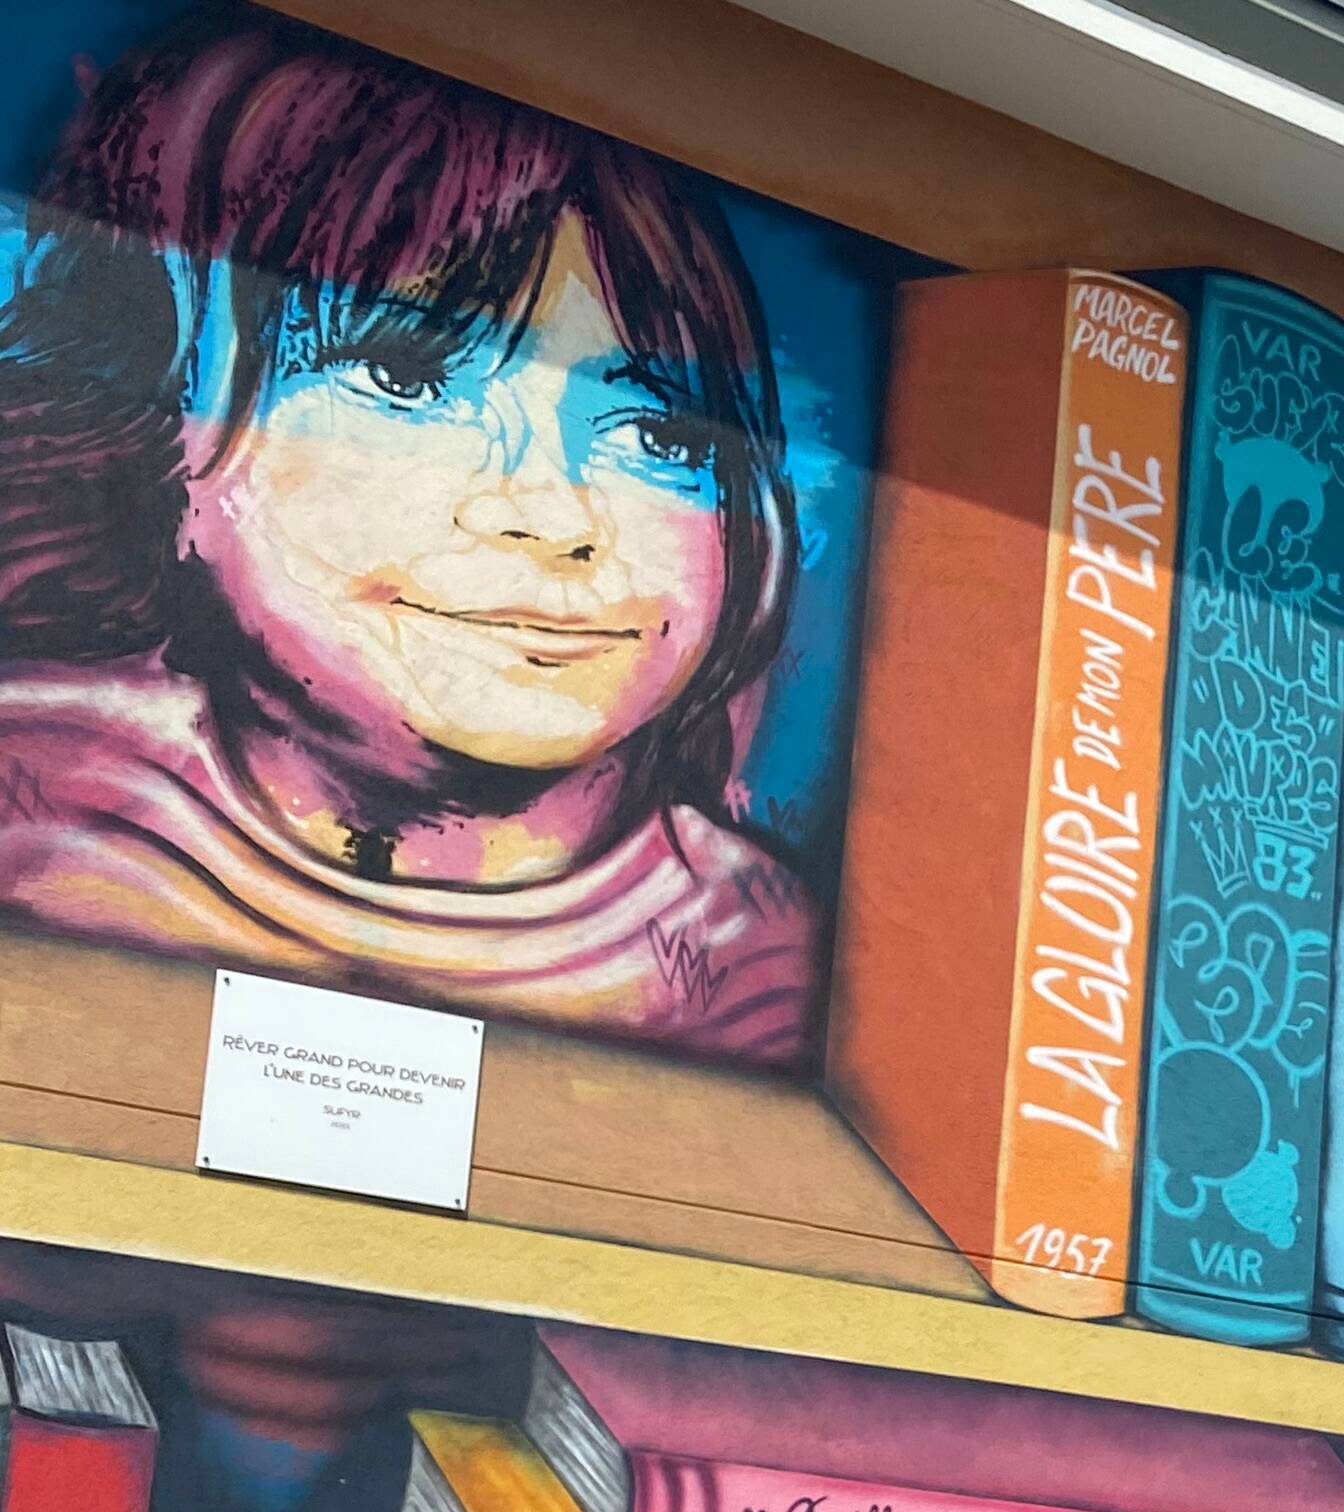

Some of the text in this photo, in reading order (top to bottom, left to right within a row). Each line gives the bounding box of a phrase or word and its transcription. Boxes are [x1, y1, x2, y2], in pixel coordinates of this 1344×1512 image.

[1073, 285, 1181, 351] MARCEL
[1072, 319, 1177, 385] PAGNOL
[1242, 320, 1321, 382] VAR
[1020, 423, 1165, 1151] LA GLOIRE DE MON PERE
[283, 1047, 344, 1068] GRAND
[348, 1058, 396, 1078] POUR
[399, 1068, 467, 1092] DEVENIR
[310, 1073, 342, 1091] DES
[346, 1080, 424, 1106] GRANDES
[1015, 1222, 1114, 1280] 1957
[1188, 1237, 1264, 1286] VAR
